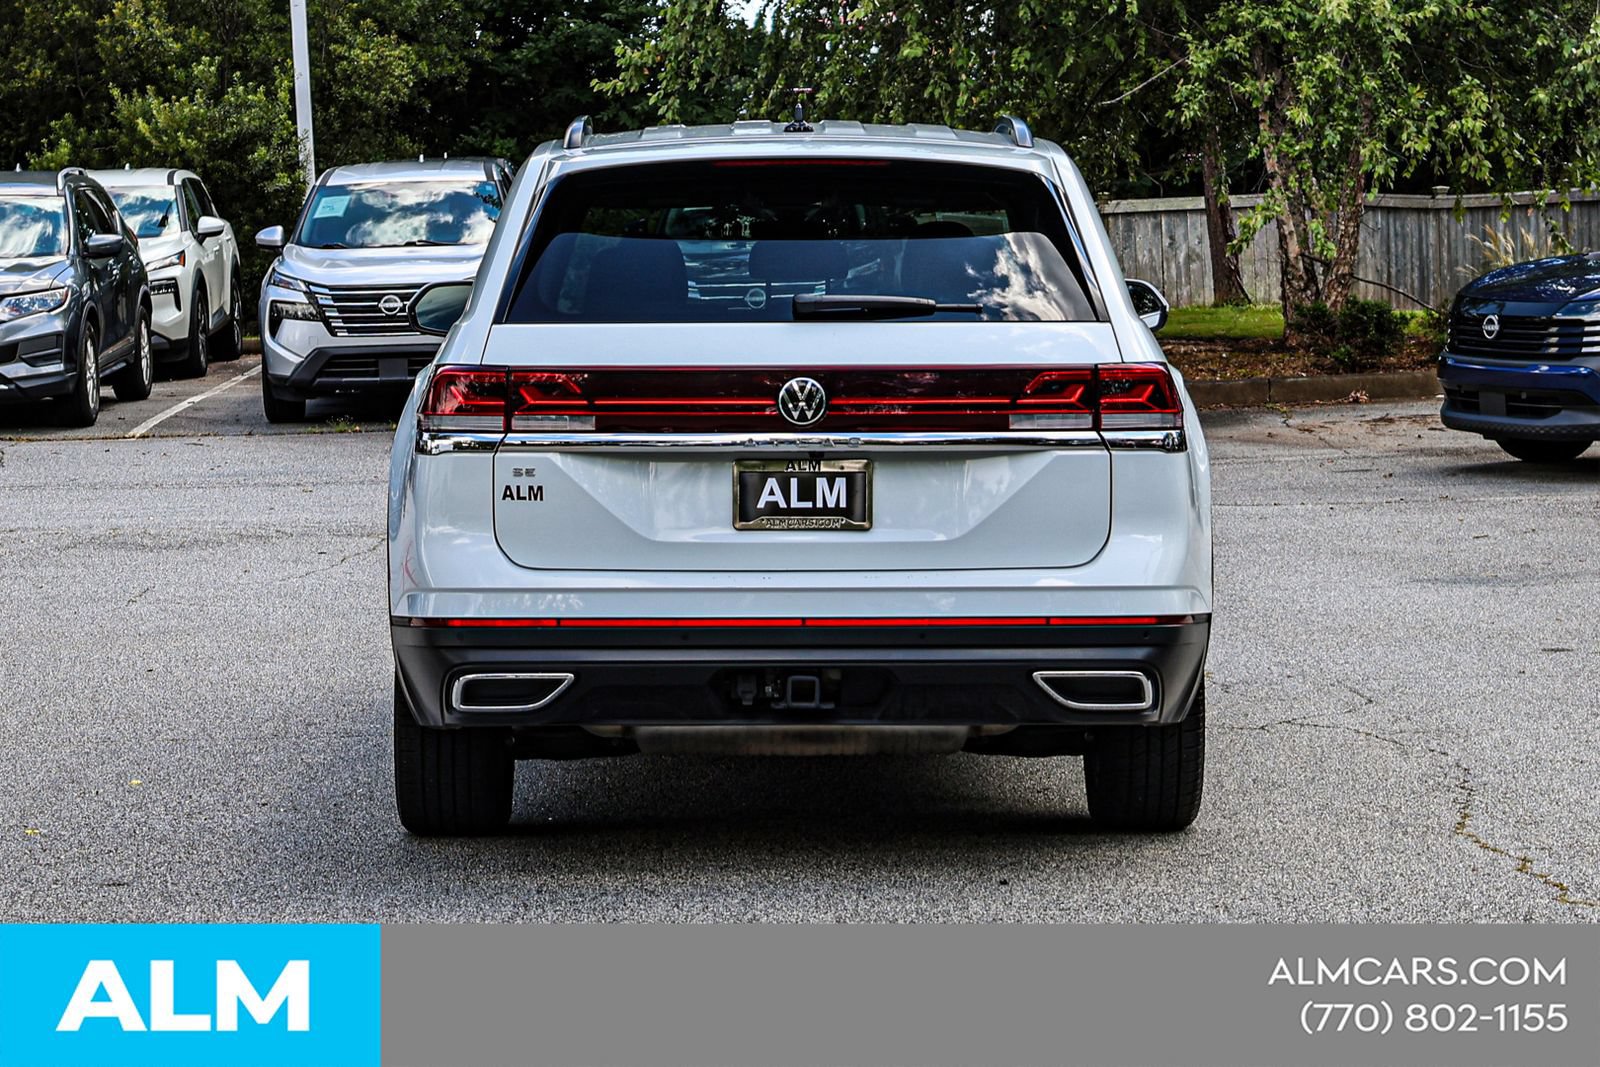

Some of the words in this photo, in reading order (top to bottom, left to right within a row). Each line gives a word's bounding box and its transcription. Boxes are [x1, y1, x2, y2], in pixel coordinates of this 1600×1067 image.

[512, 467, 536, 477] SE
[785, 460, 821, 472] ALM
[501, 484, 544, 501] ALM
[757, 477, 847, 509] ALM
